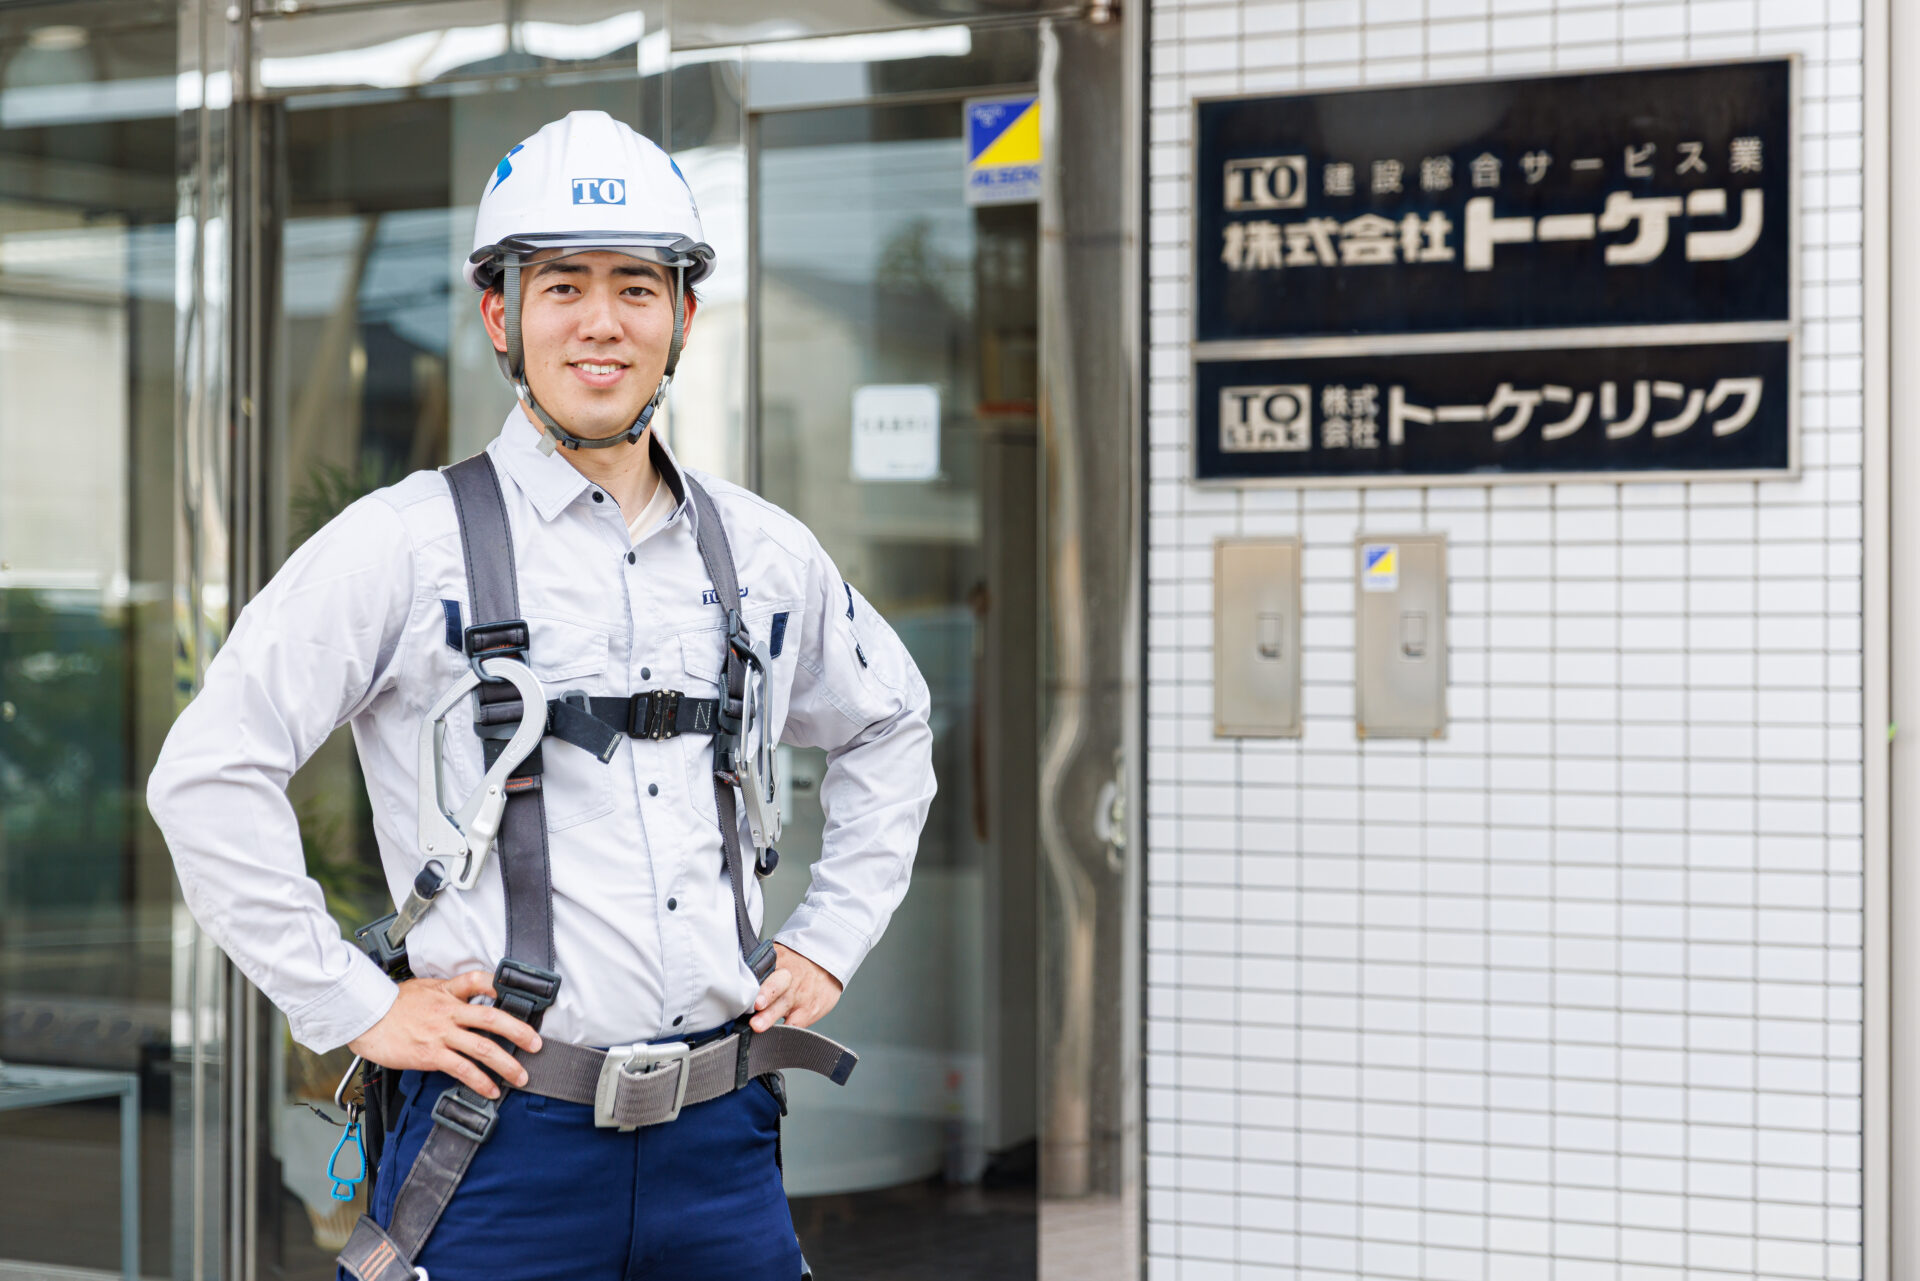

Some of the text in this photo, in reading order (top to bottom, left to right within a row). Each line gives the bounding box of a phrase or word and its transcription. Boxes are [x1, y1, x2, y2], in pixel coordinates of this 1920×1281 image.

[573, 179, 624, 204] TO
[1231, 164, 1299, 202] TO
[1232, 393, 1301, 424] TO
[1387, 376, 1763, 445] トーケンリンク
